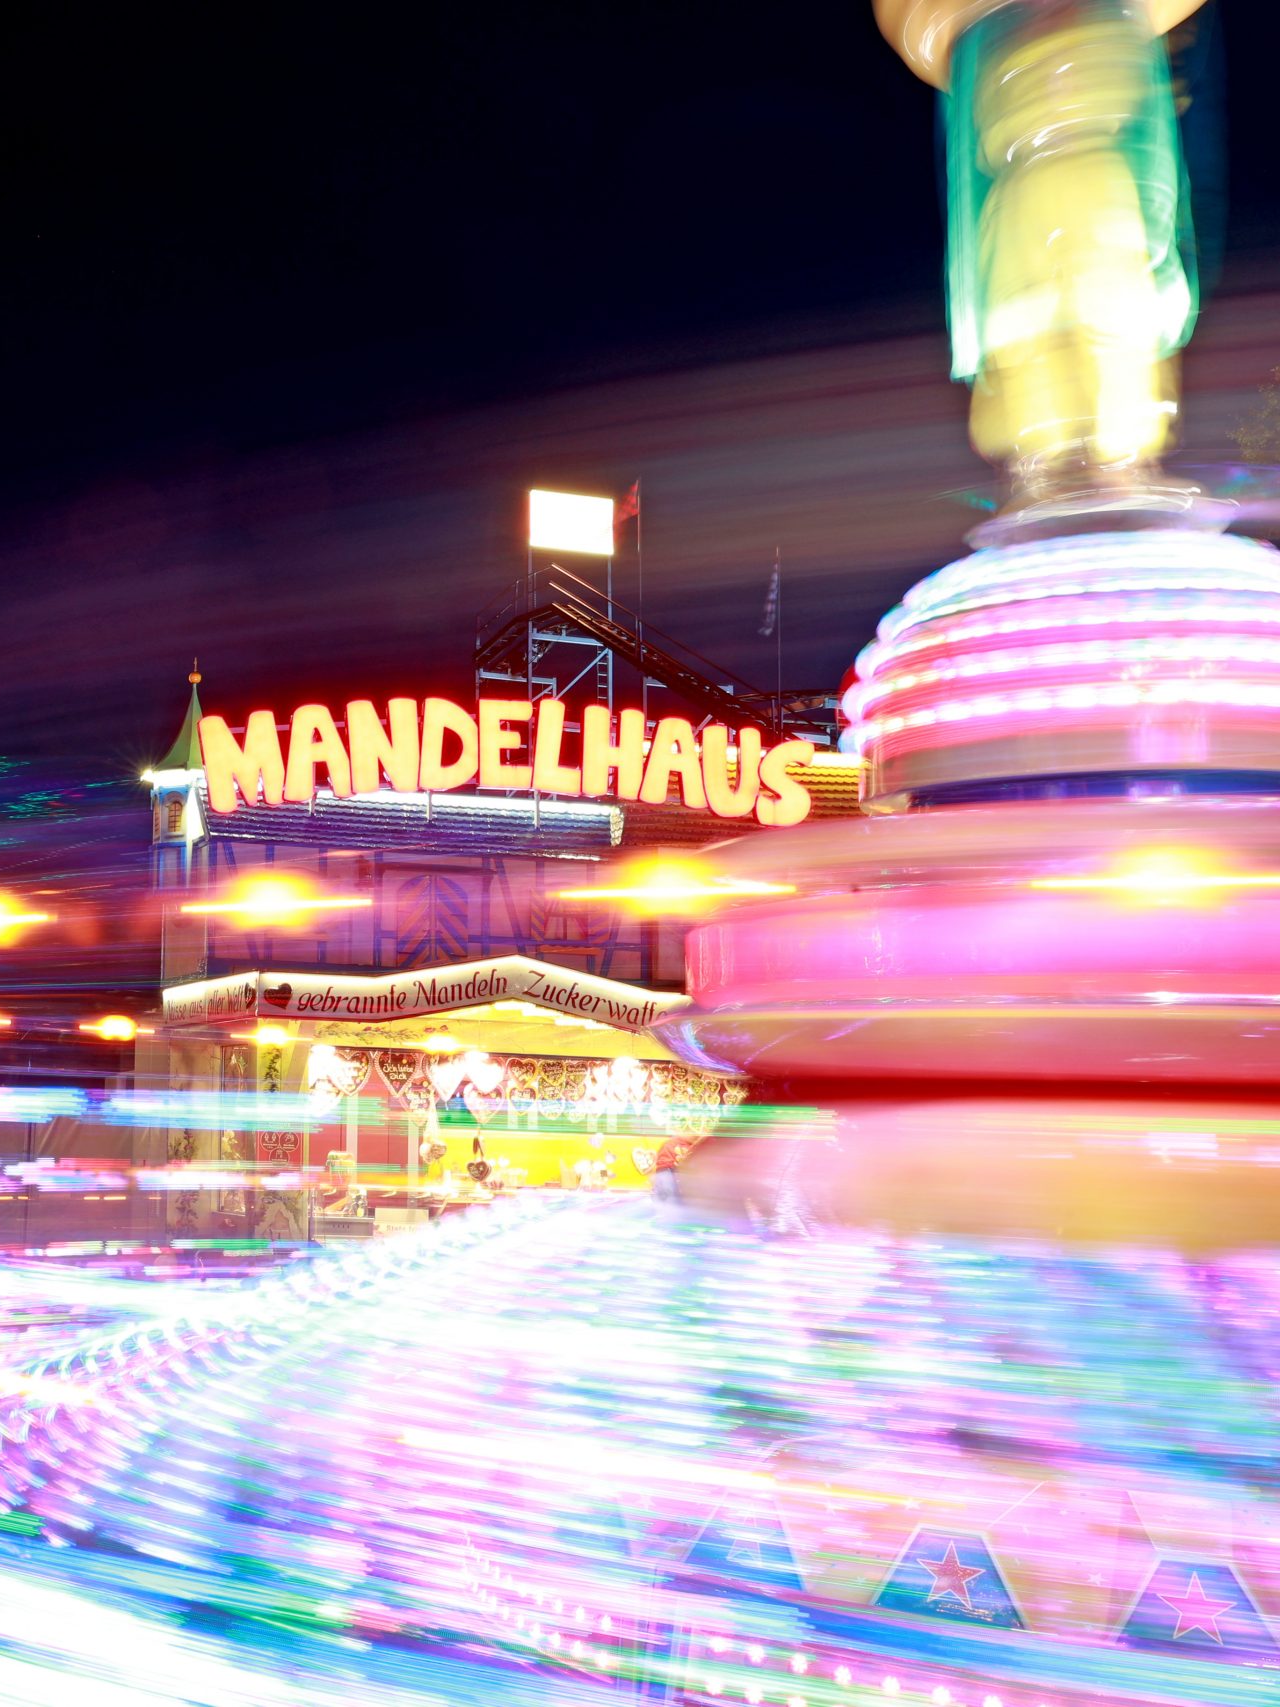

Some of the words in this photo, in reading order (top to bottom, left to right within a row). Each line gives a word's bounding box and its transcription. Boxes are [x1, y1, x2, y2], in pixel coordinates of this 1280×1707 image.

[198, 697, 816, 827] MANDELHAUS
[297, 984, 407, 1014] gebrannte
[413, 969, 508, 1009] Mandeln
